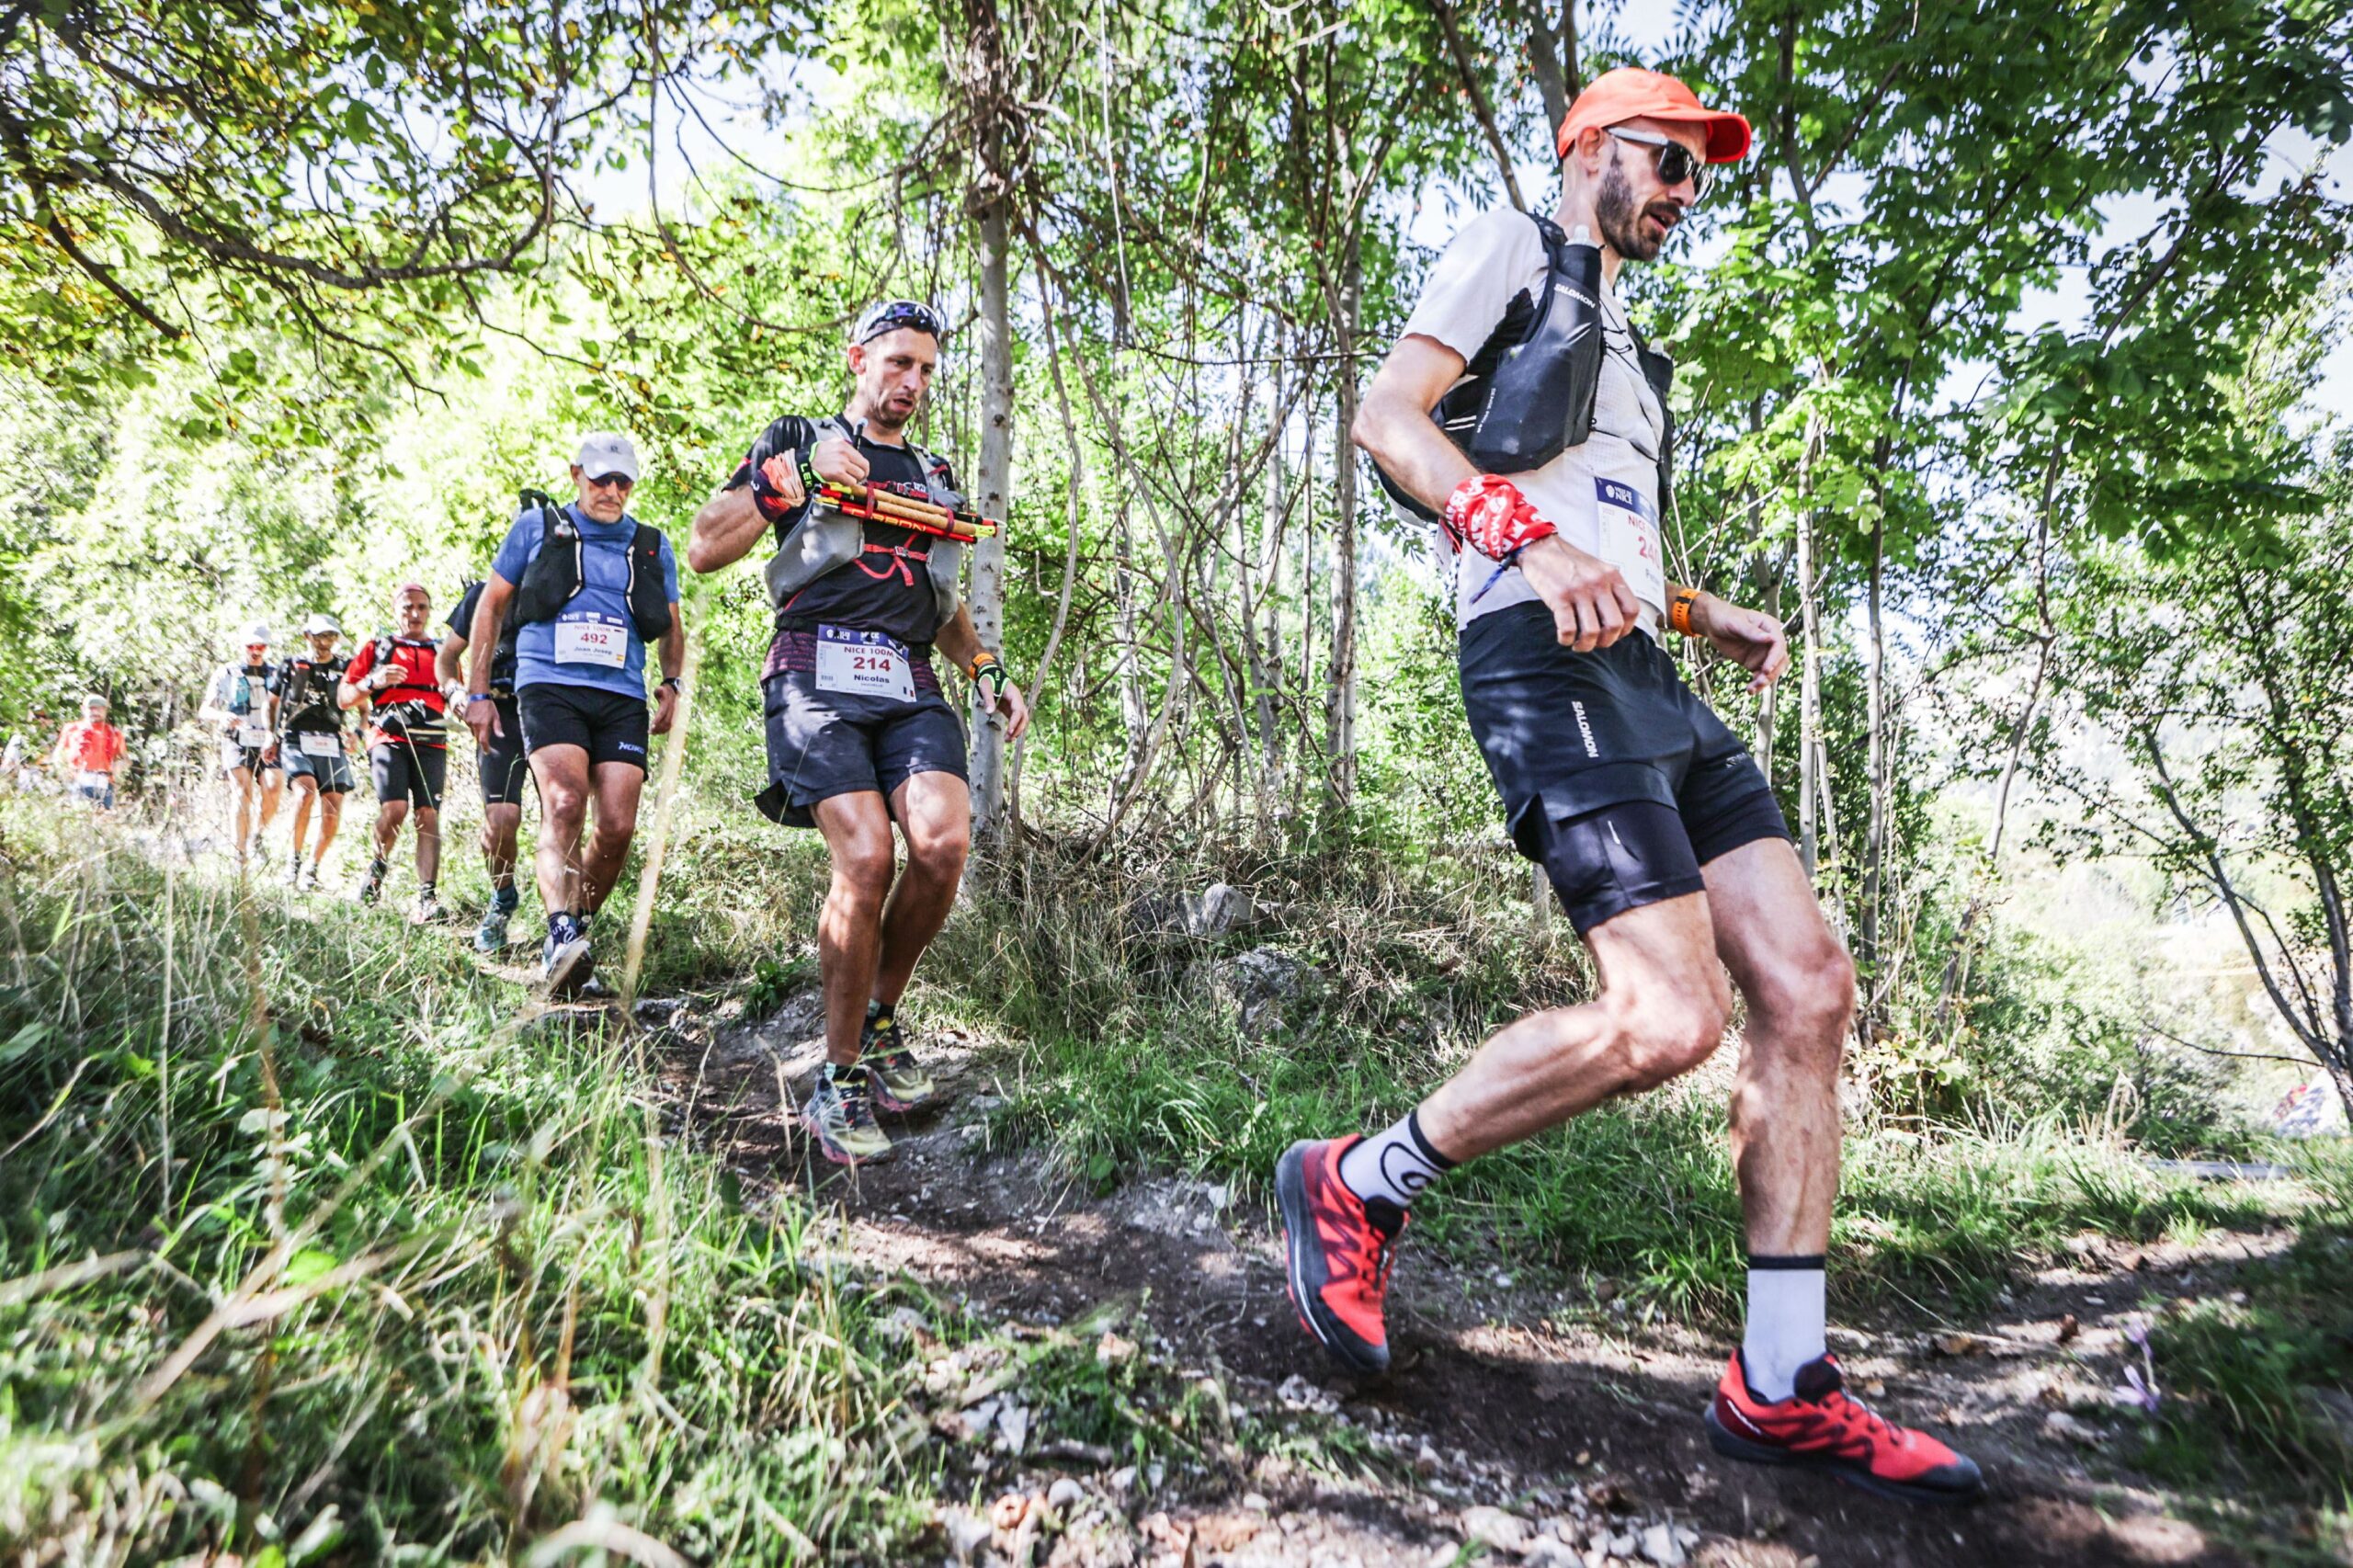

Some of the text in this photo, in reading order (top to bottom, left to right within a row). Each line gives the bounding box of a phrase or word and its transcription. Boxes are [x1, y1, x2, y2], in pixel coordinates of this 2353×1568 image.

[1553, 283, 1596, 309] SALOMON
[850, 508, 926, 532] CRBON
[581, 632, 608, 645] 492
[844, 646, 894, 658] NICE 100M
[853, 656, 892, 672] 214
[854, 674, 890, 684] Nicolas
[1572, 700, 1599, 758] SALOMON
